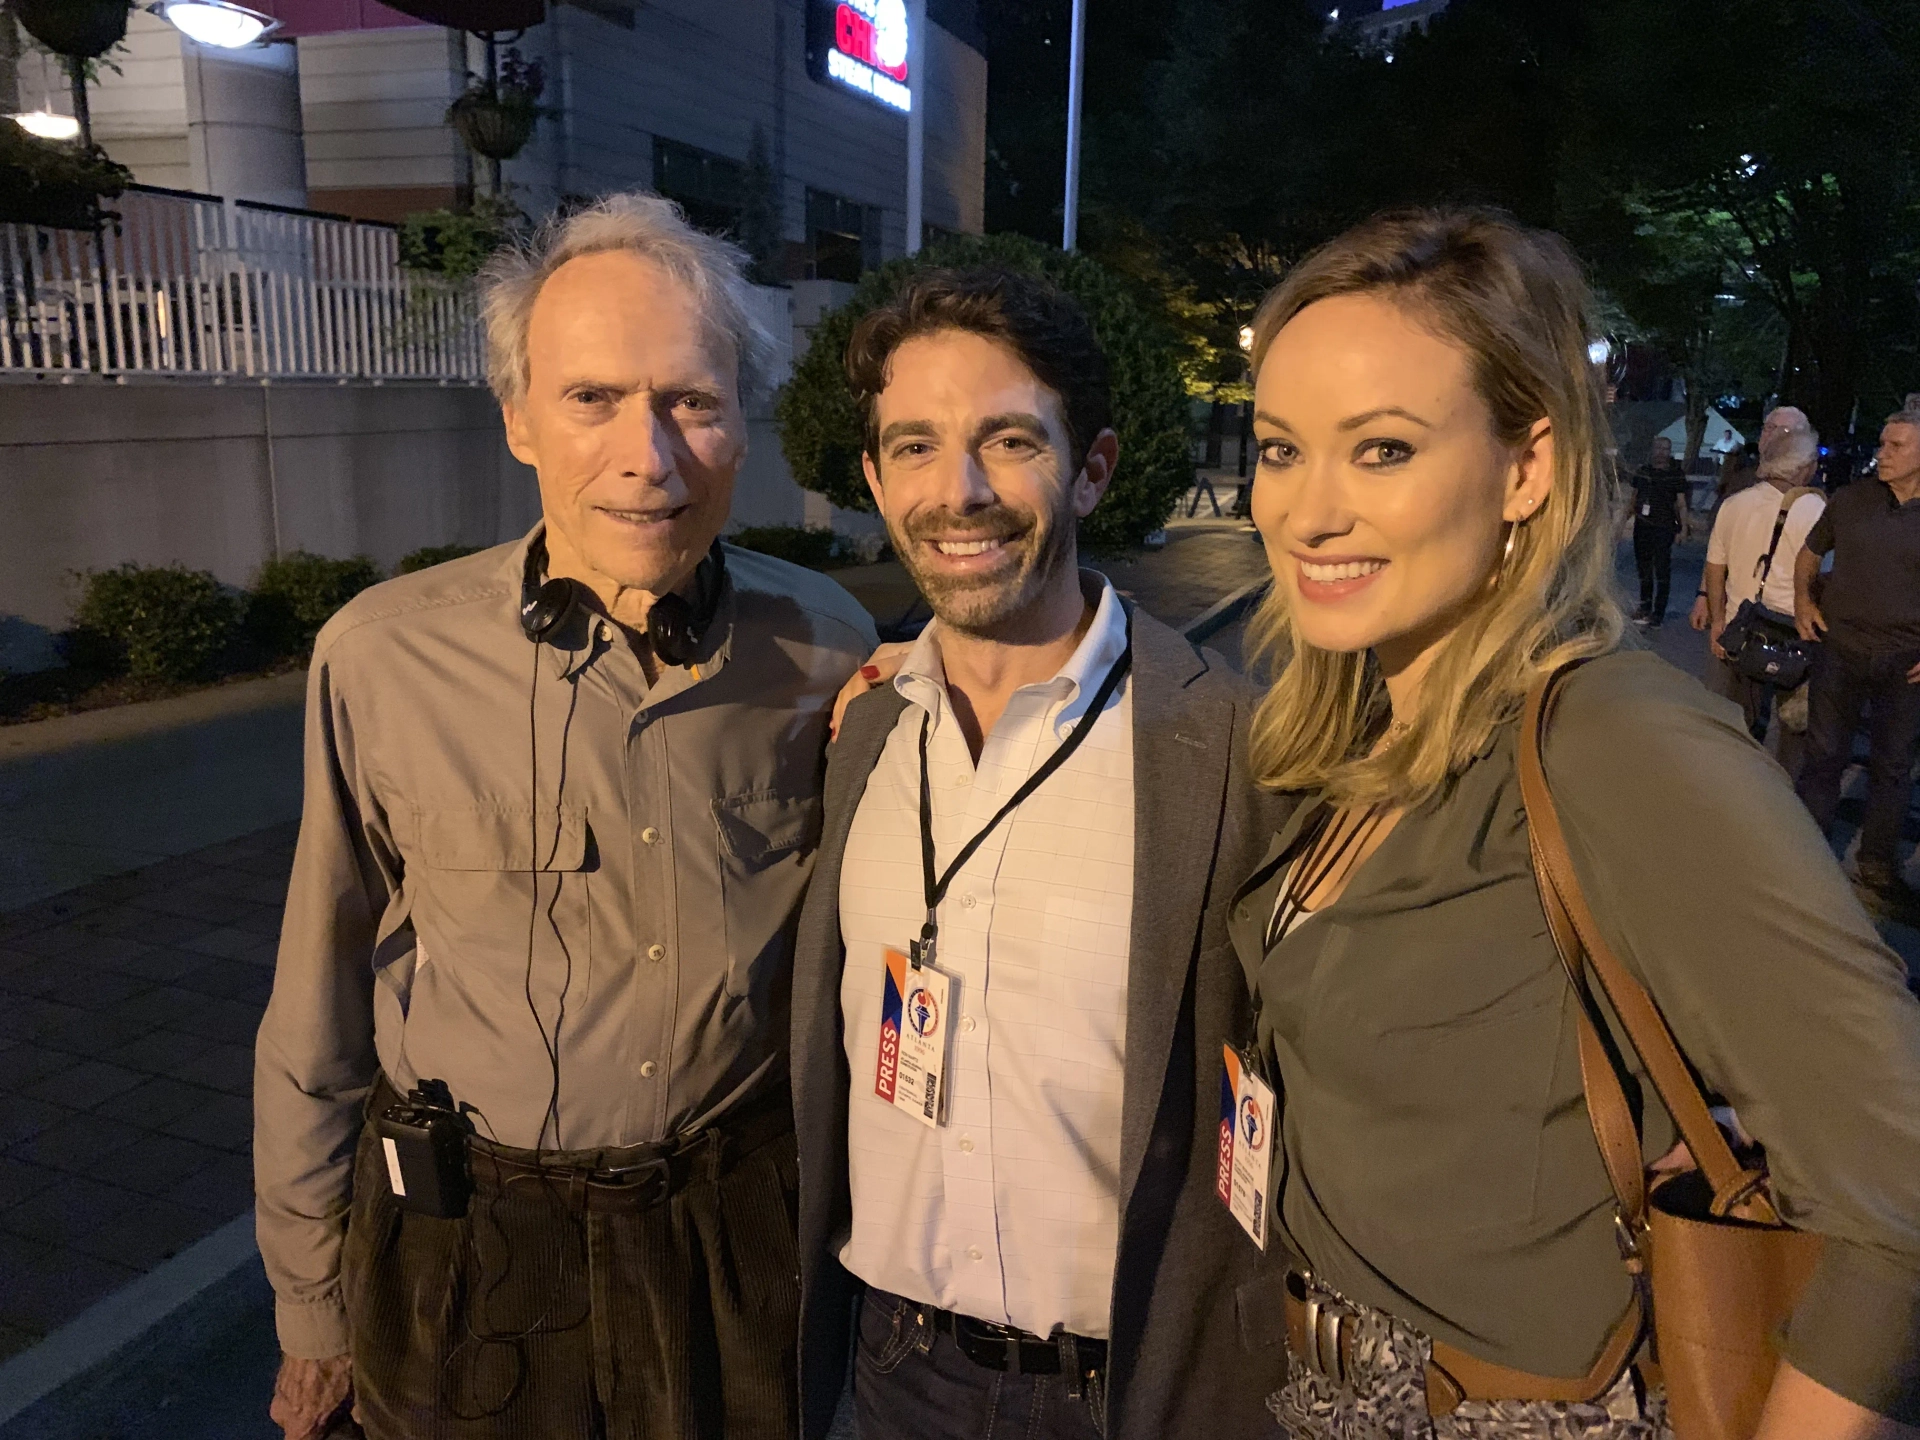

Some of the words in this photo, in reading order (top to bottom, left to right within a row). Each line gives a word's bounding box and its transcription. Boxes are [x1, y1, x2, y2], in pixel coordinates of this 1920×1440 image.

[879, 1026, 897, 1095] PRESS
[906, 1033, 935, 1053] ATLANTA
[1218, 1126, 1232, 1199] PRESS
